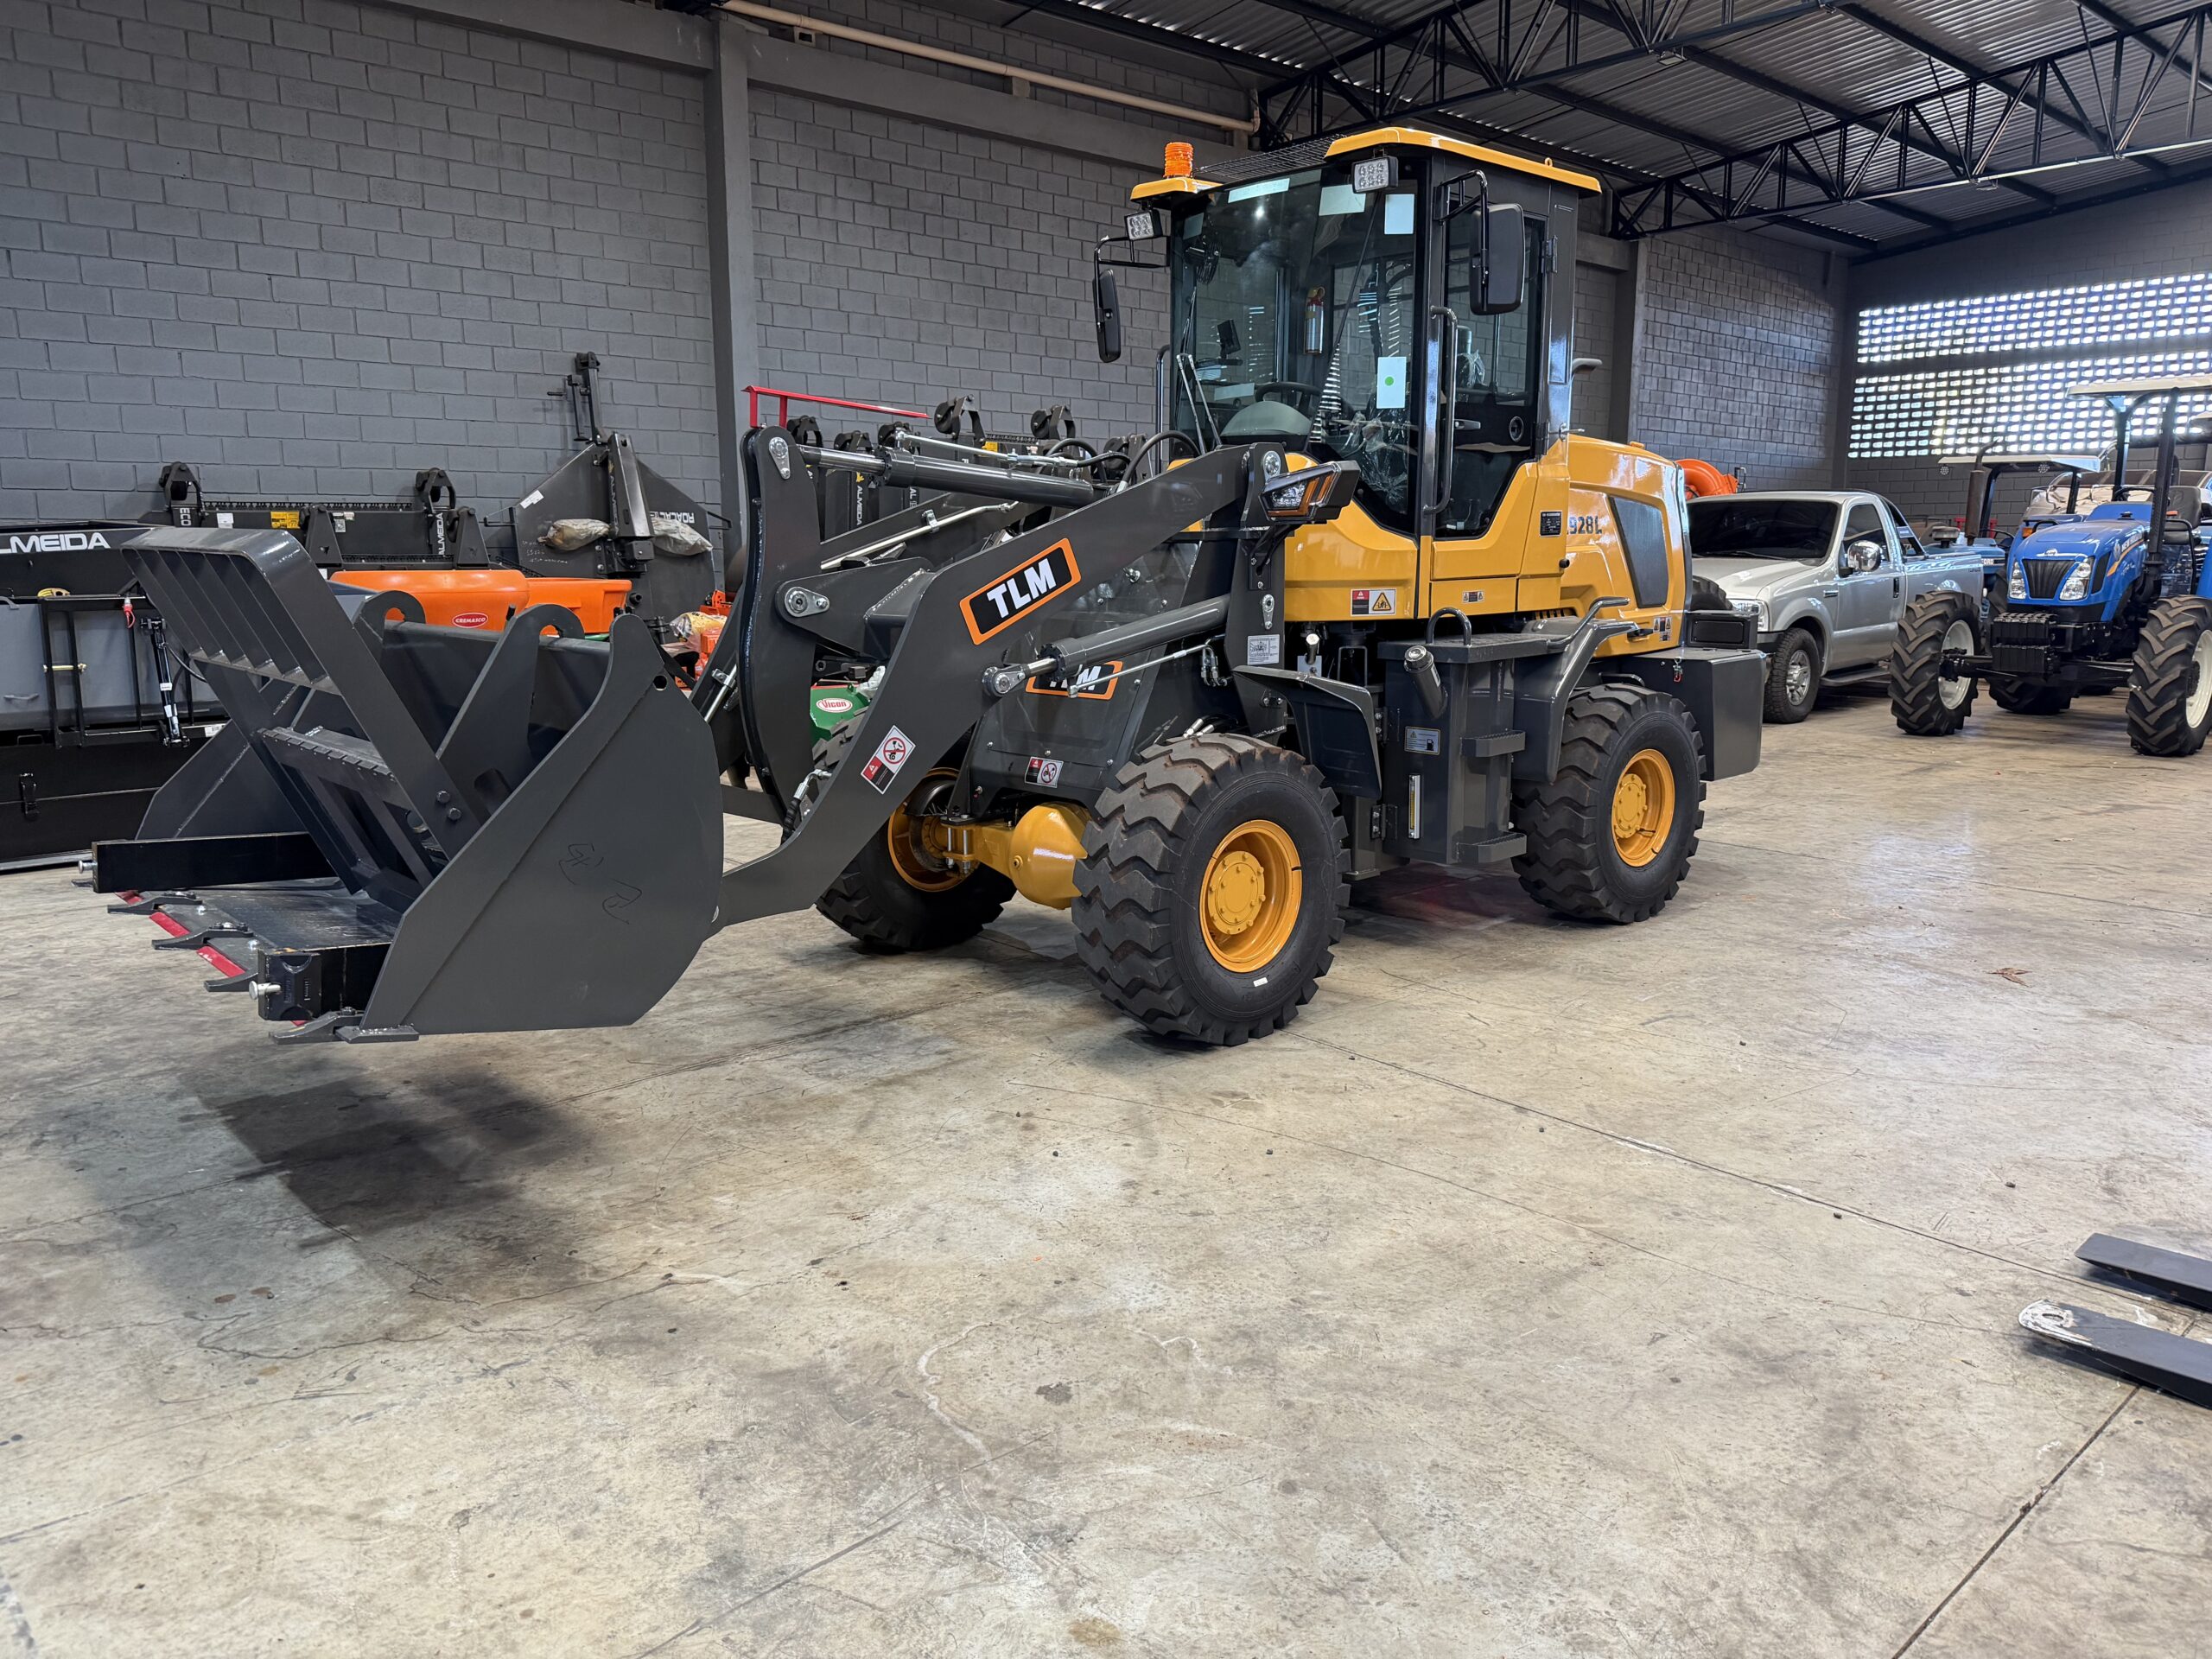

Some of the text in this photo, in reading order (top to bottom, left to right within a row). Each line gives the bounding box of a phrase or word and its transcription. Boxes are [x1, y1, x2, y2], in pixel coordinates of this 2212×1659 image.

[179, 508, 192, 526] ECO
[1567, 515, 1603, 535] 928L
[986, 557, 1057, 619] TLM
[821, 700, 847, 709] Vicon
